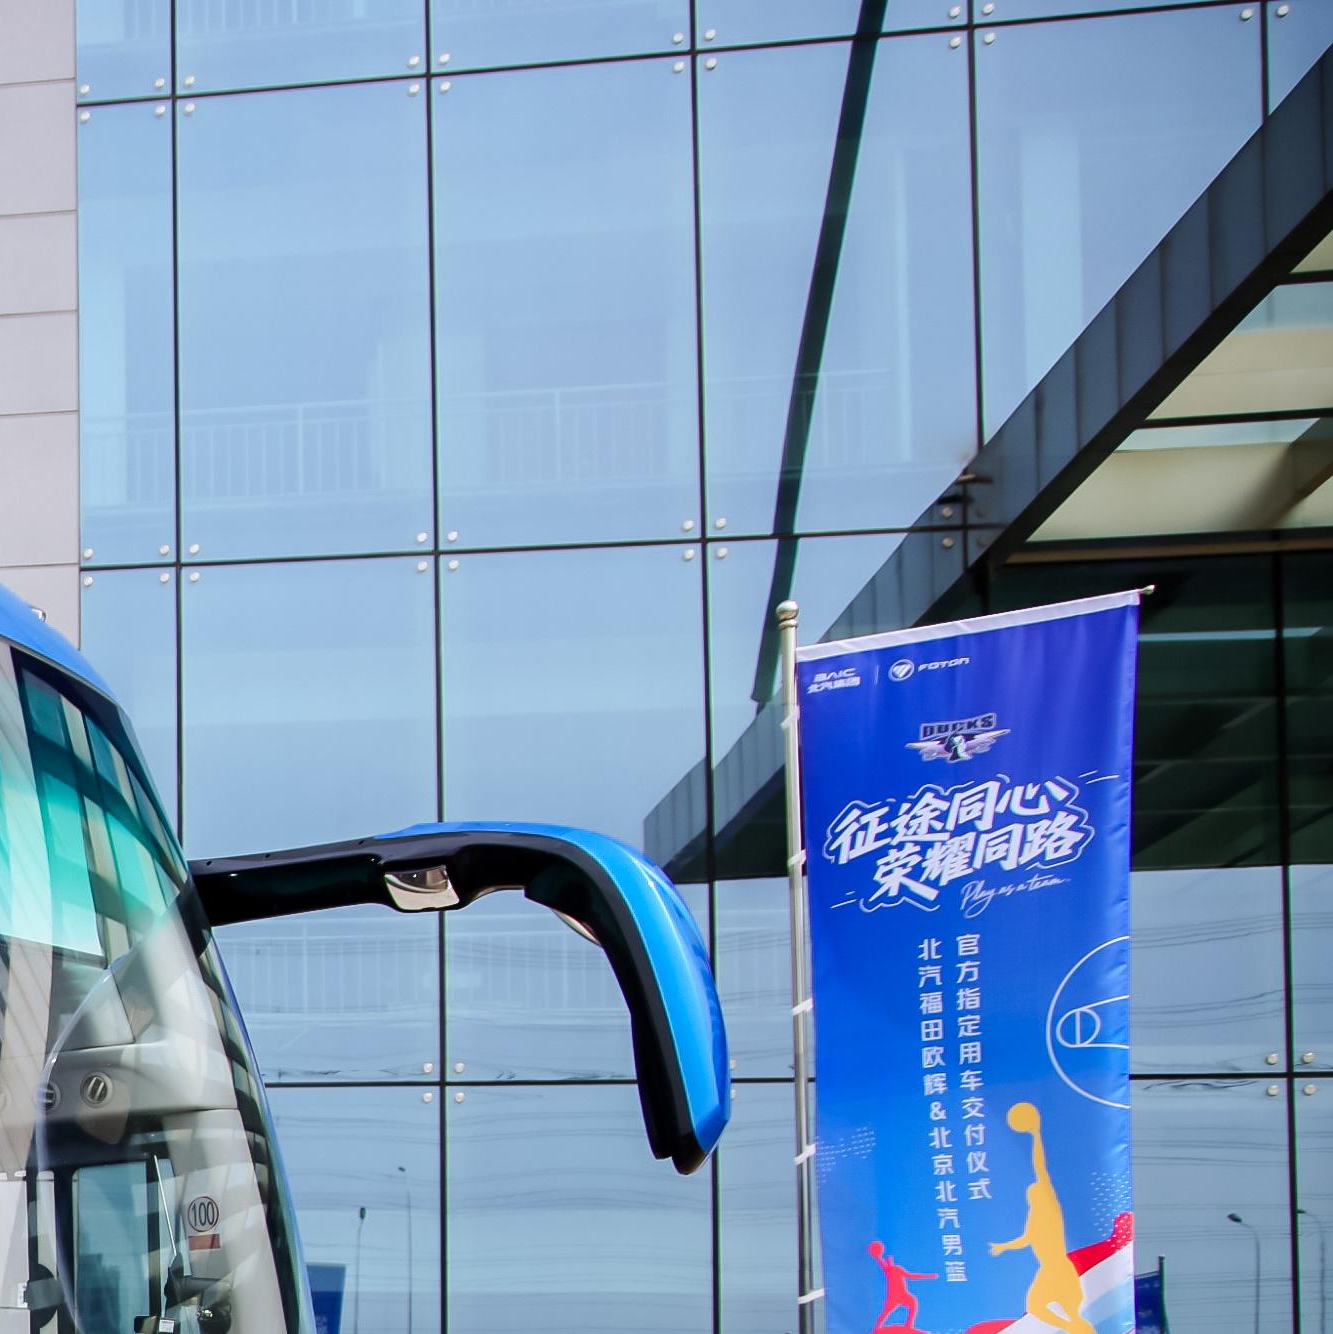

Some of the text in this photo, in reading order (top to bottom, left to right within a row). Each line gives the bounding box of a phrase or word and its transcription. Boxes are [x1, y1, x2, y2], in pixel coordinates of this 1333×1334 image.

[813, 667, 857, 683] BAIC
[920, 713, 997, 741] DUCKS
[827, 778, 1067, 866] 征途同心
[867, 813, 1088, 902] 荣耀同路
[959, 879, 997, 919] Play
[955, 933, 993, 1201] 官方指定用车交付仪式
[192, 1201, 215, 1227] 100
